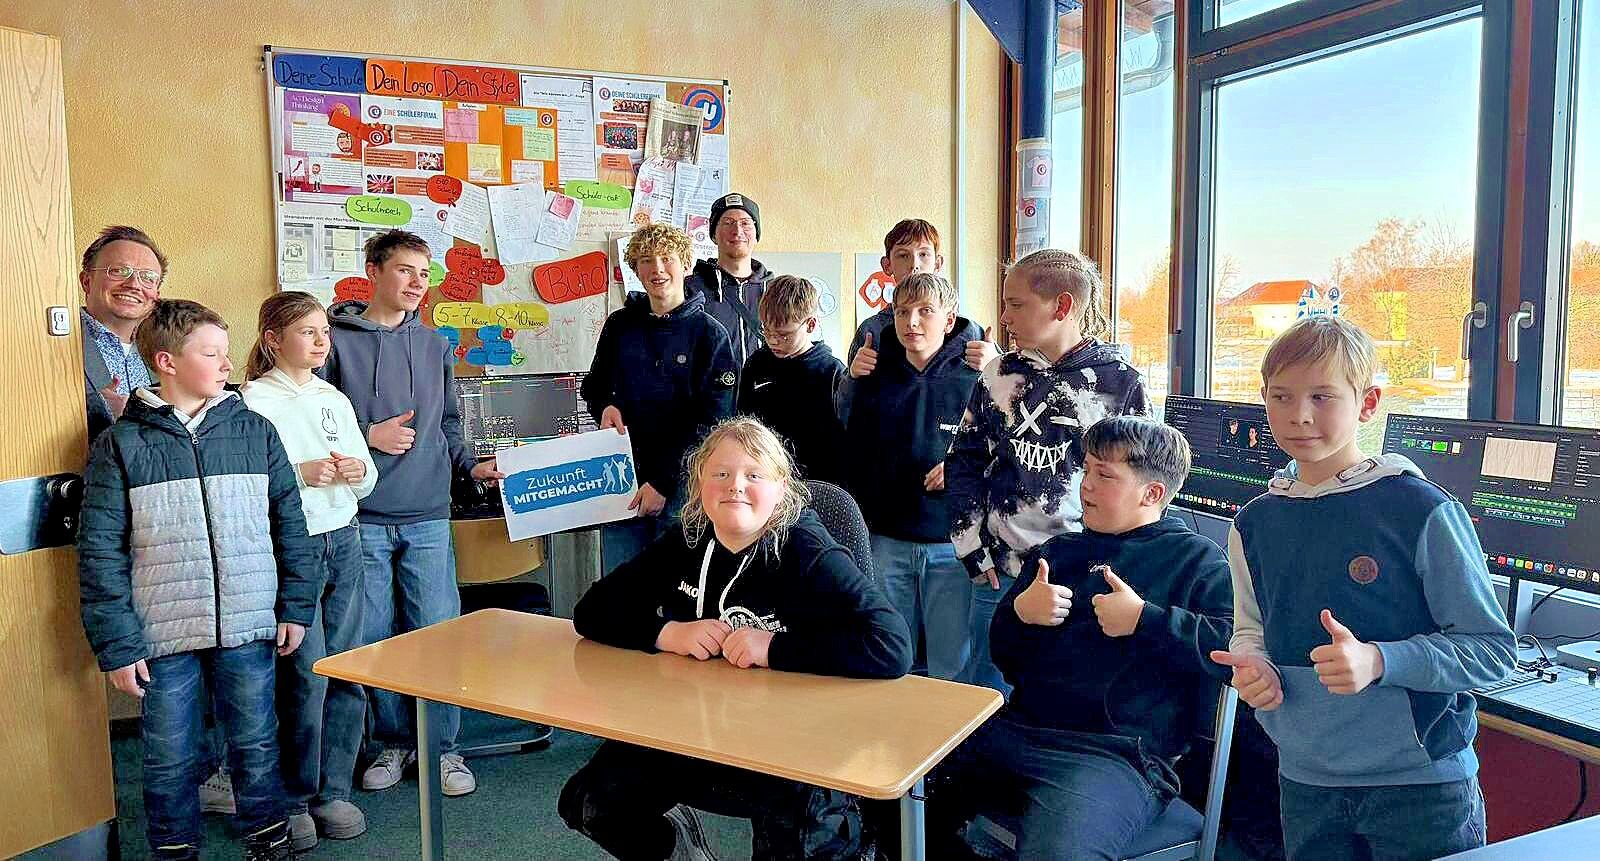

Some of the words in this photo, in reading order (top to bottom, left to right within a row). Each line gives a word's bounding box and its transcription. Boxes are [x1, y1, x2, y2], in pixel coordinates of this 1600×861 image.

[279, 60, 316, 84] Deine
[371, 64, 399, 91] Dein
[442, 69, 480, 97] Dein
[482, 72, 515, 101] Style
[383, 109, 396, 117] EINE
[543, 266, 605, 301] Büro
[527, 468, 586, 490] Zukunft
[513, 478, 604, 505] MITGEMACHT
[677, 580, 699, 598] JAKO
